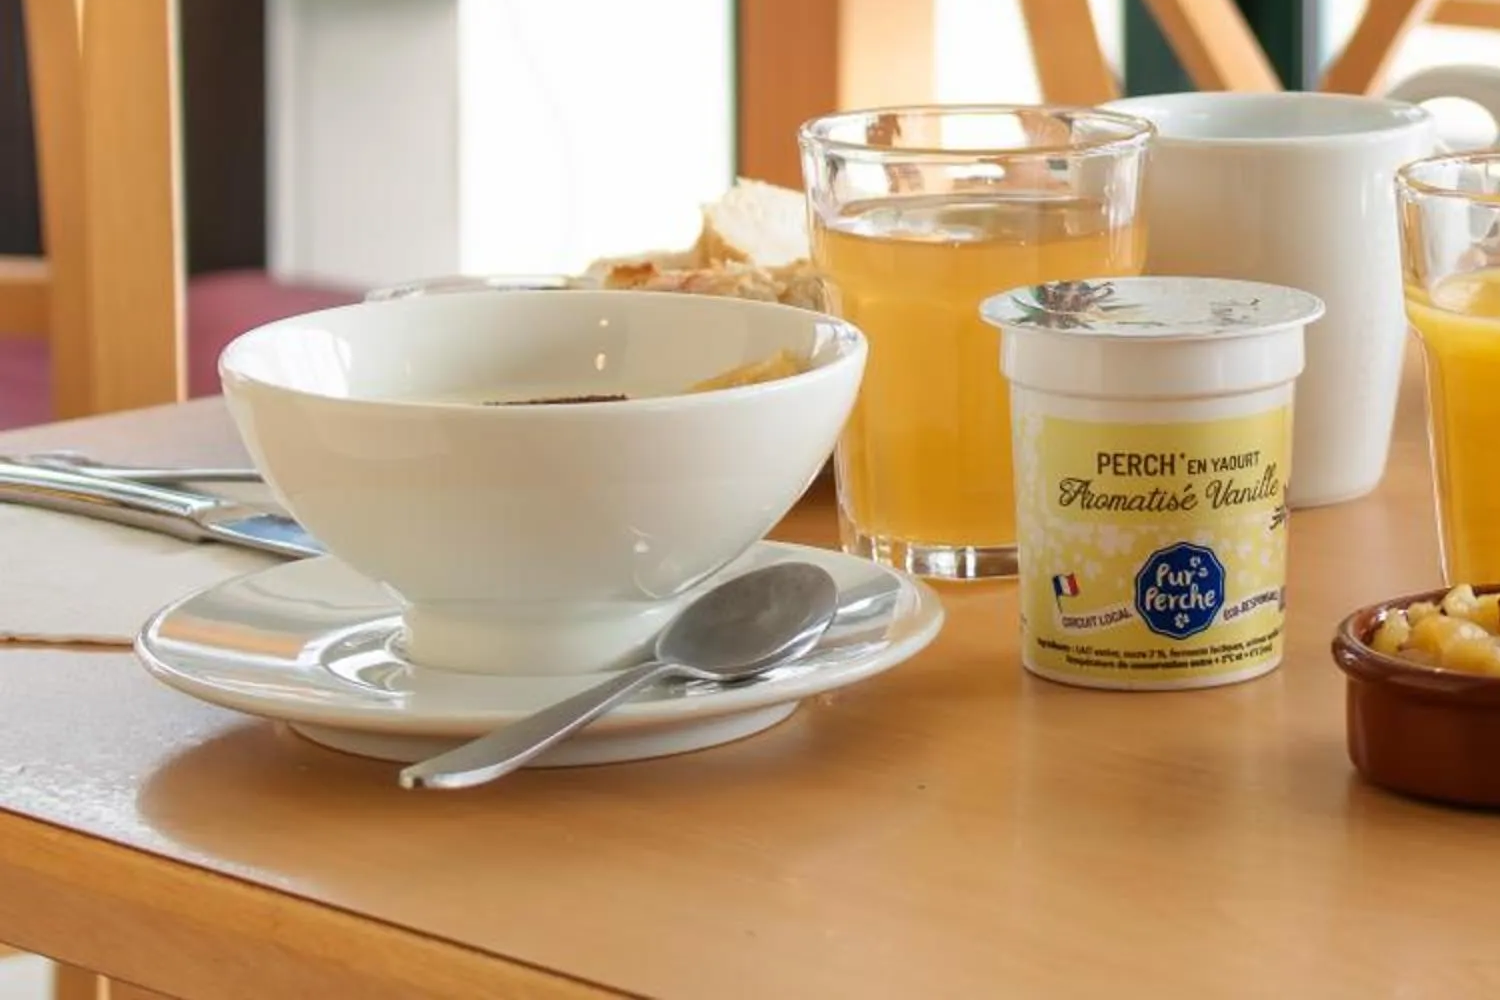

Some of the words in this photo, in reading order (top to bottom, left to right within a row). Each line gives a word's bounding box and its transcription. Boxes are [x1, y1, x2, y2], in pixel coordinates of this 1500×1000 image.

[1211, 450, 1260, 473] YAOURT
[1058, 476, 1199, 513] Aromatisé
[1205, 463, 1279, 510] Vanille
[1145, 583, 1216, 611] Perche
[1098, 607, 1134, 626] LOCAL
